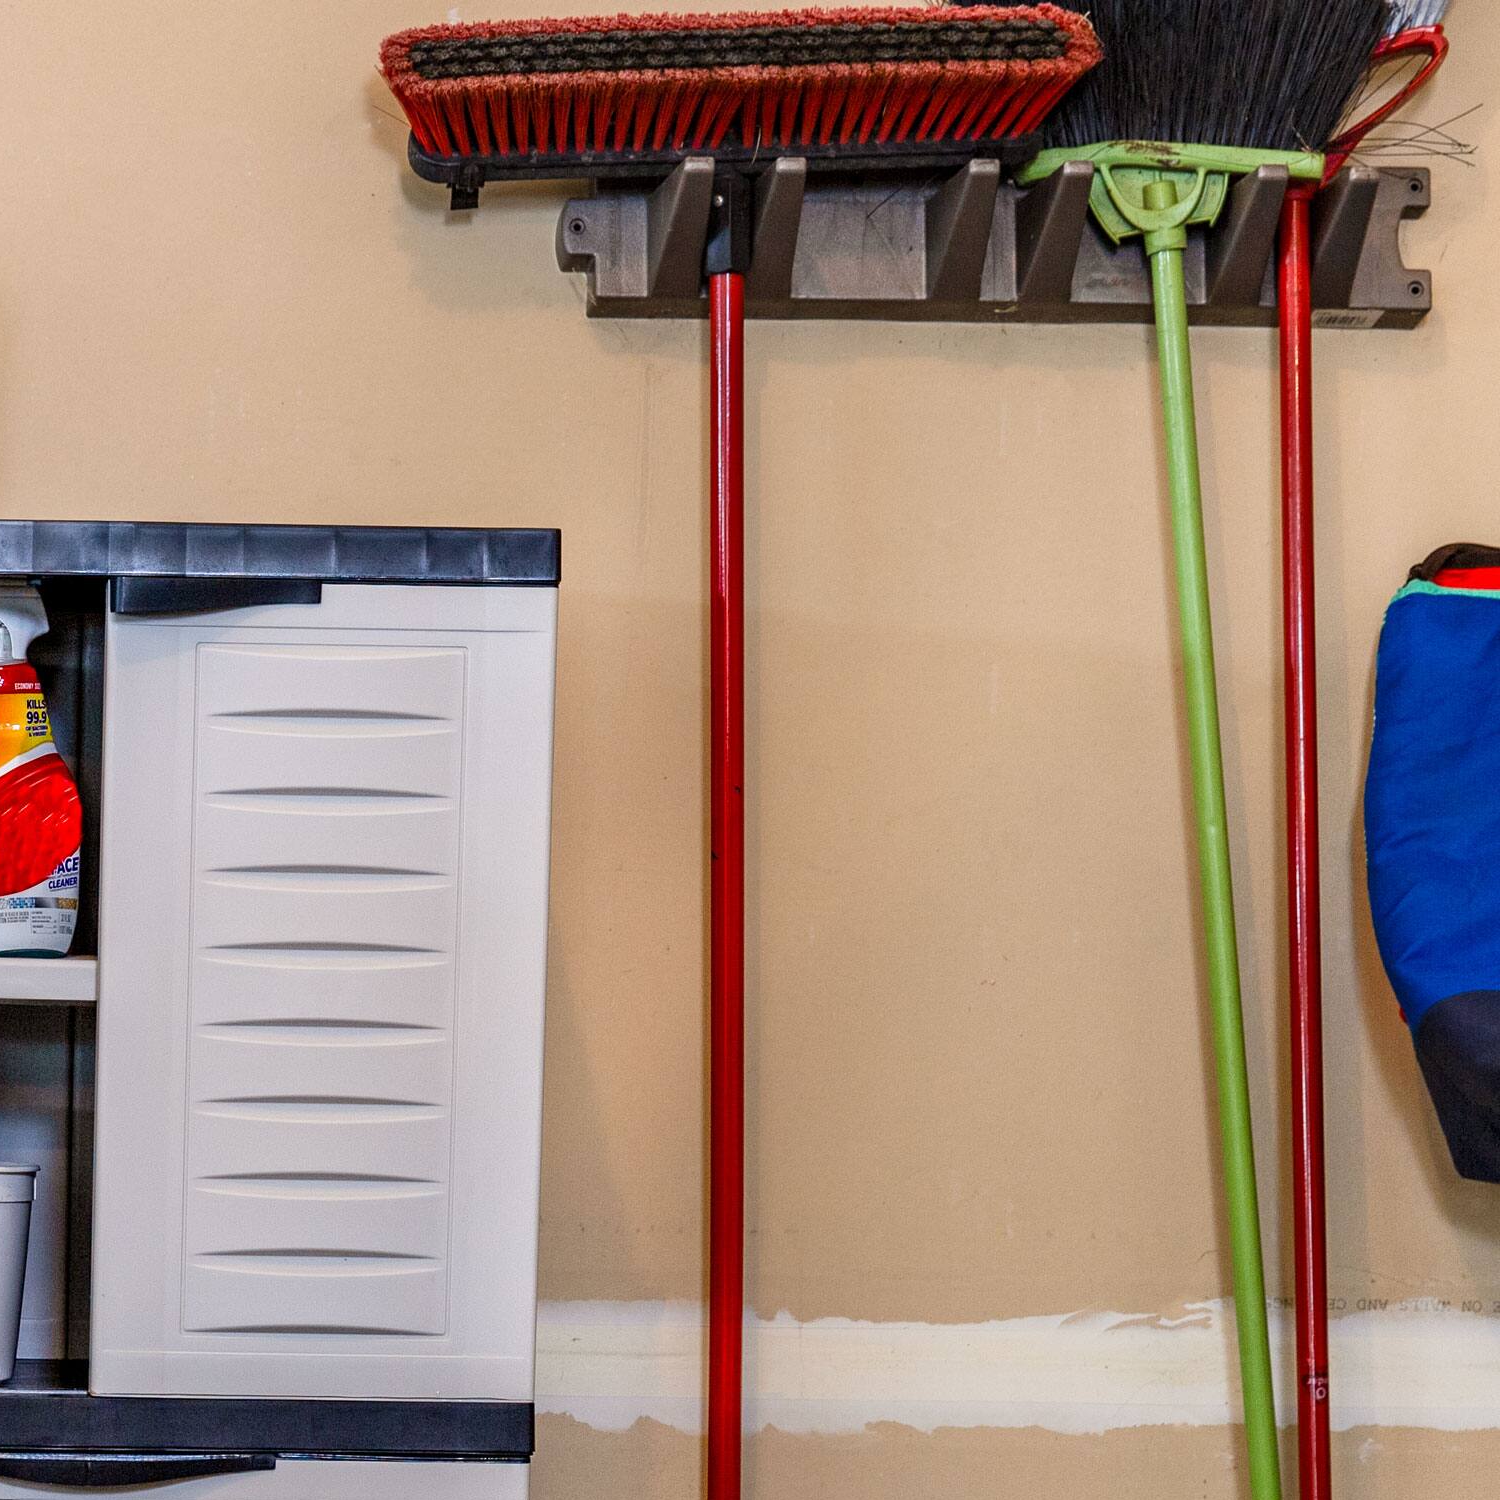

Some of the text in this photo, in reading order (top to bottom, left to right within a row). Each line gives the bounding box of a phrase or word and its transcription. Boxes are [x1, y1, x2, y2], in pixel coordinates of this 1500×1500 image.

[26, 699, 47, 709] KILLS
[26, 711, 47, 724] 99.9
[48, 876, 77, 889] CLEANER
[1356, 1299, 1389, 1311] AND
